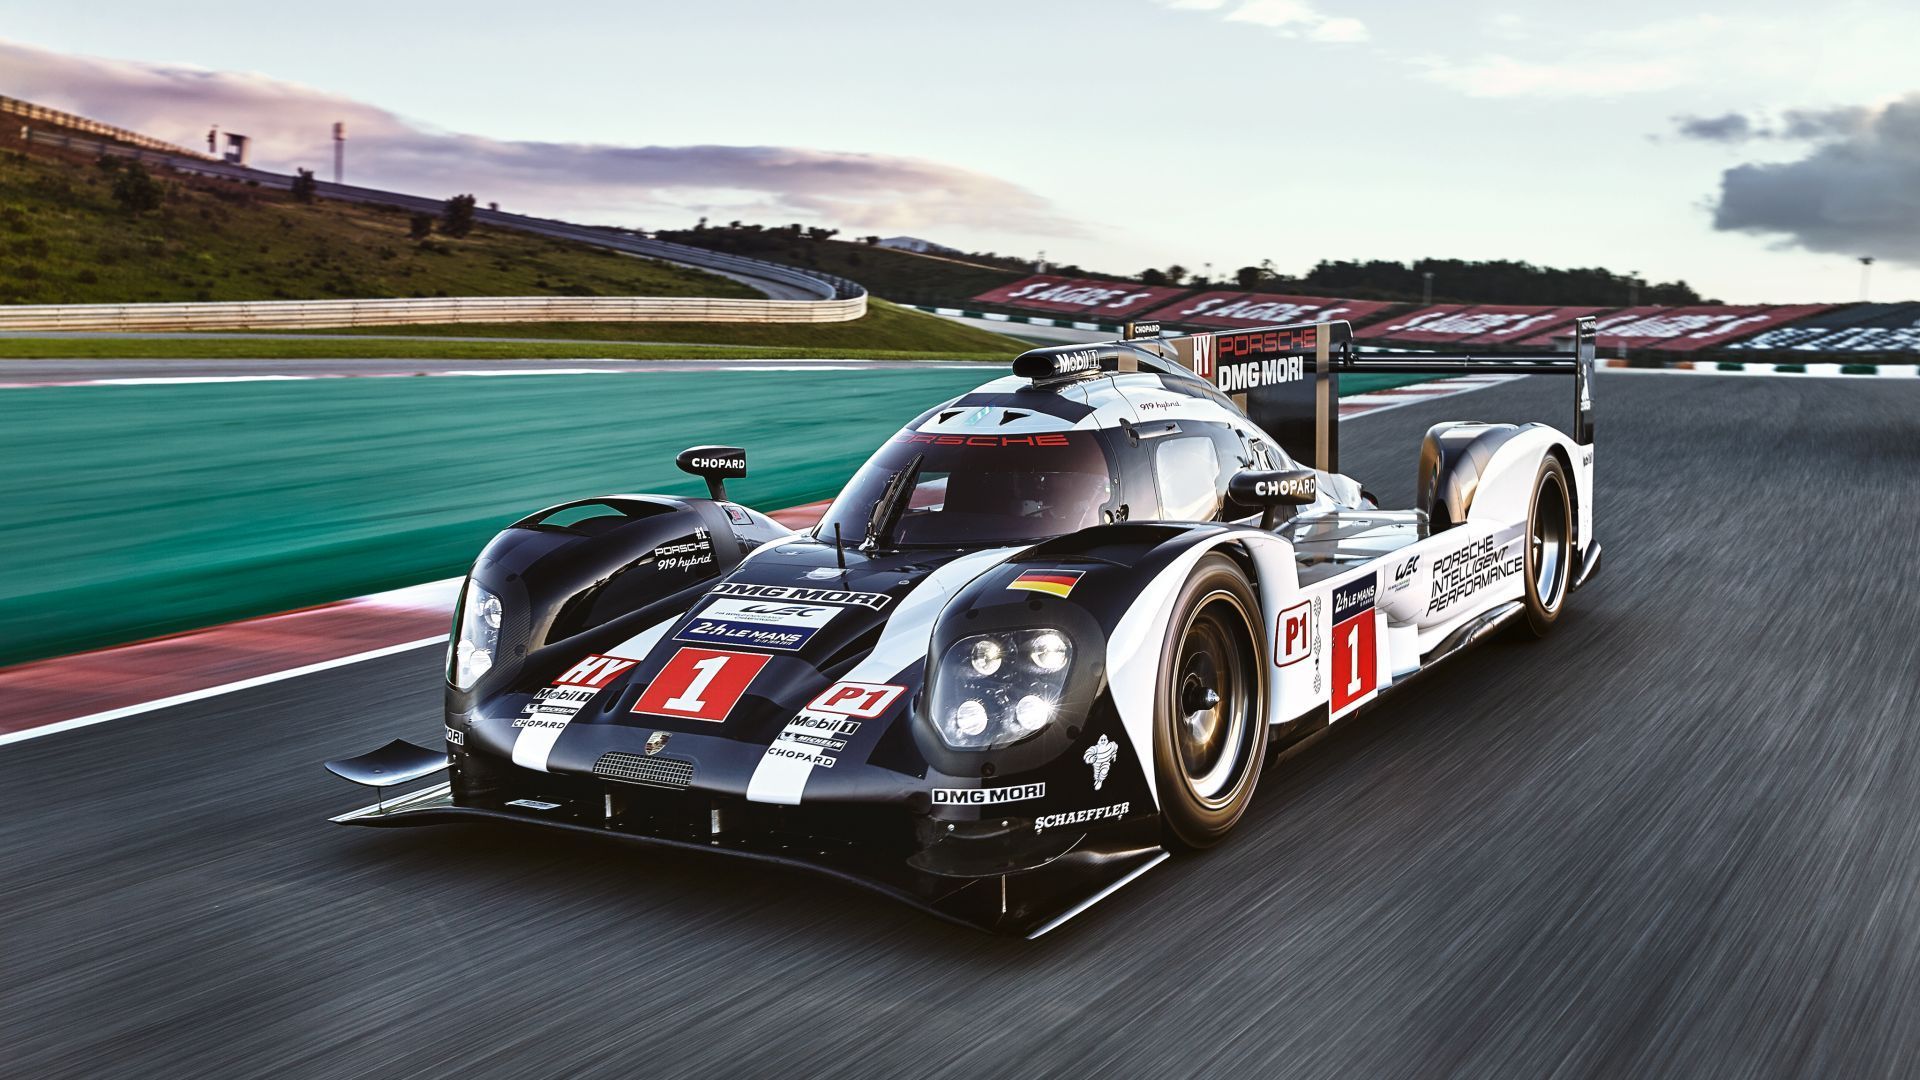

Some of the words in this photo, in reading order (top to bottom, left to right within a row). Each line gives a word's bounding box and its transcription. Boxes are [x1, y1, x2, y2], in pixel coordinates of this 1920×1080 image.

[1008, 283, 1152, 308] SAGRES
[1135, 324, 1160, 334] CHOPARD
[1218, 329, 1317, 358] PORSCHE
[1056, 351, 1089, 373] Mobil
[1193, 335, 1211, 375] HY
[1218, 362, 1260, 392] DMG
[1261, 356, 1304, 386] MORI
[1140, 402, 1154, 411] 919
[893, 434, 1070, 447] ORSCHE
[691, 457, 745, 469] CHOPARD
[1255, 478, 1315, 496] CHOPARD
[655, 541, 710, 557] PORSCHE
[1432, 534, 1494, 579] PORSCHE
[657, 557, 676, 570] 919
[677, 553, 712, 573] hybrid
[1395, 554, 1420, 581] WEC
[1431, 545, 1509, 598] INTELLIGENT
[1348, 595, 1356, 608] LE
[1357, 585, 1375, 602] MANS
[1425, 556, 1523, 618] PERFORMANCE
[788, 589, 892, 609] MORI
[739, 604, 826, 617] WEC
[725, 629, 750, 638] LE
[748, 631, 803, 643] MANS
[1286, 612, 1306, 656] P1
[1347, 623, 1361, 697] 1
[556, 656, 637, 686] HY
[662, 656, 731, 712] 1
[536, 689, 577, 701] Mobil
[823, 687, 889, 711] P1
[513, 719, 566, 729] CHOPARD
[790, 715, 841, 732] Mobil
[445, 726, 464, 745] ORI
[797, 735, 846, 749] MICHELIN
[768, 747, 834, 767] CHOPARD
[933, 789, 985, 803] DMG
[990, 784, 1044, 802] MORI
[1034, 801, 1130, 830] SCHAEFFLER
